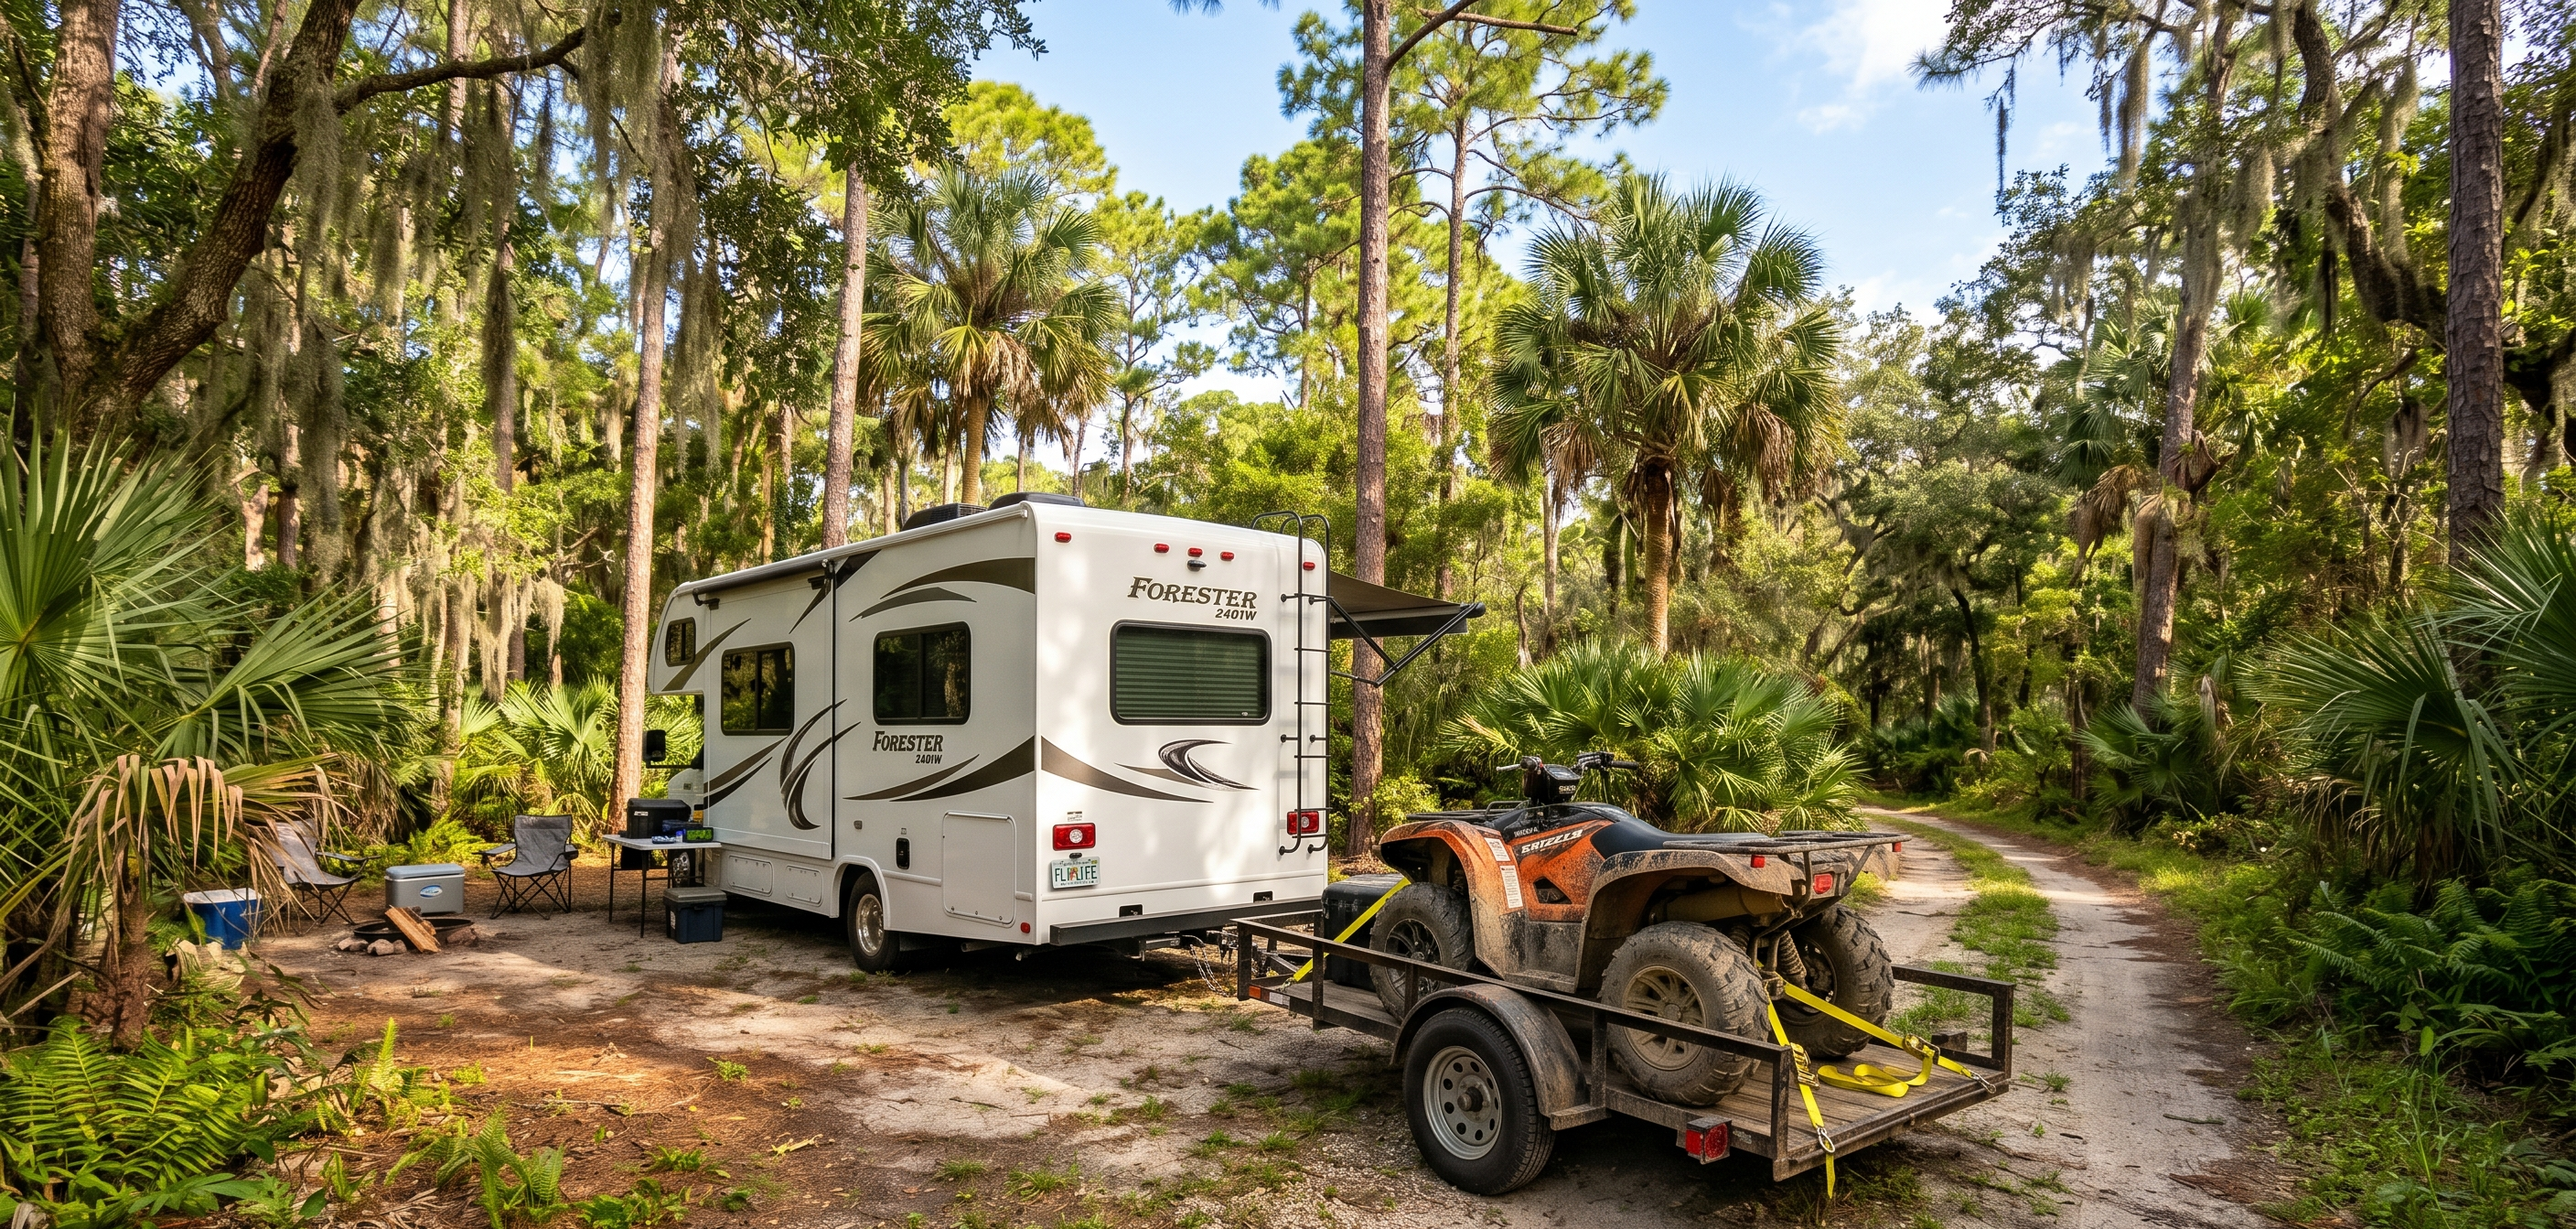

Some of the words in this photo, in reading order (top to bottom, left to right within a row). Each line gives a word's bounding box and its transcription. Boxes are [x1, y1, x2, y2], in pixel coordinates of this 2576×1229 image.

[1127, 576, 1258, 609] FORESTER
[1215, 608, 1258, 621] 2401W
[872, 730, 944, 752] FORESTER
[915, 754, 943, 764] 2401W
